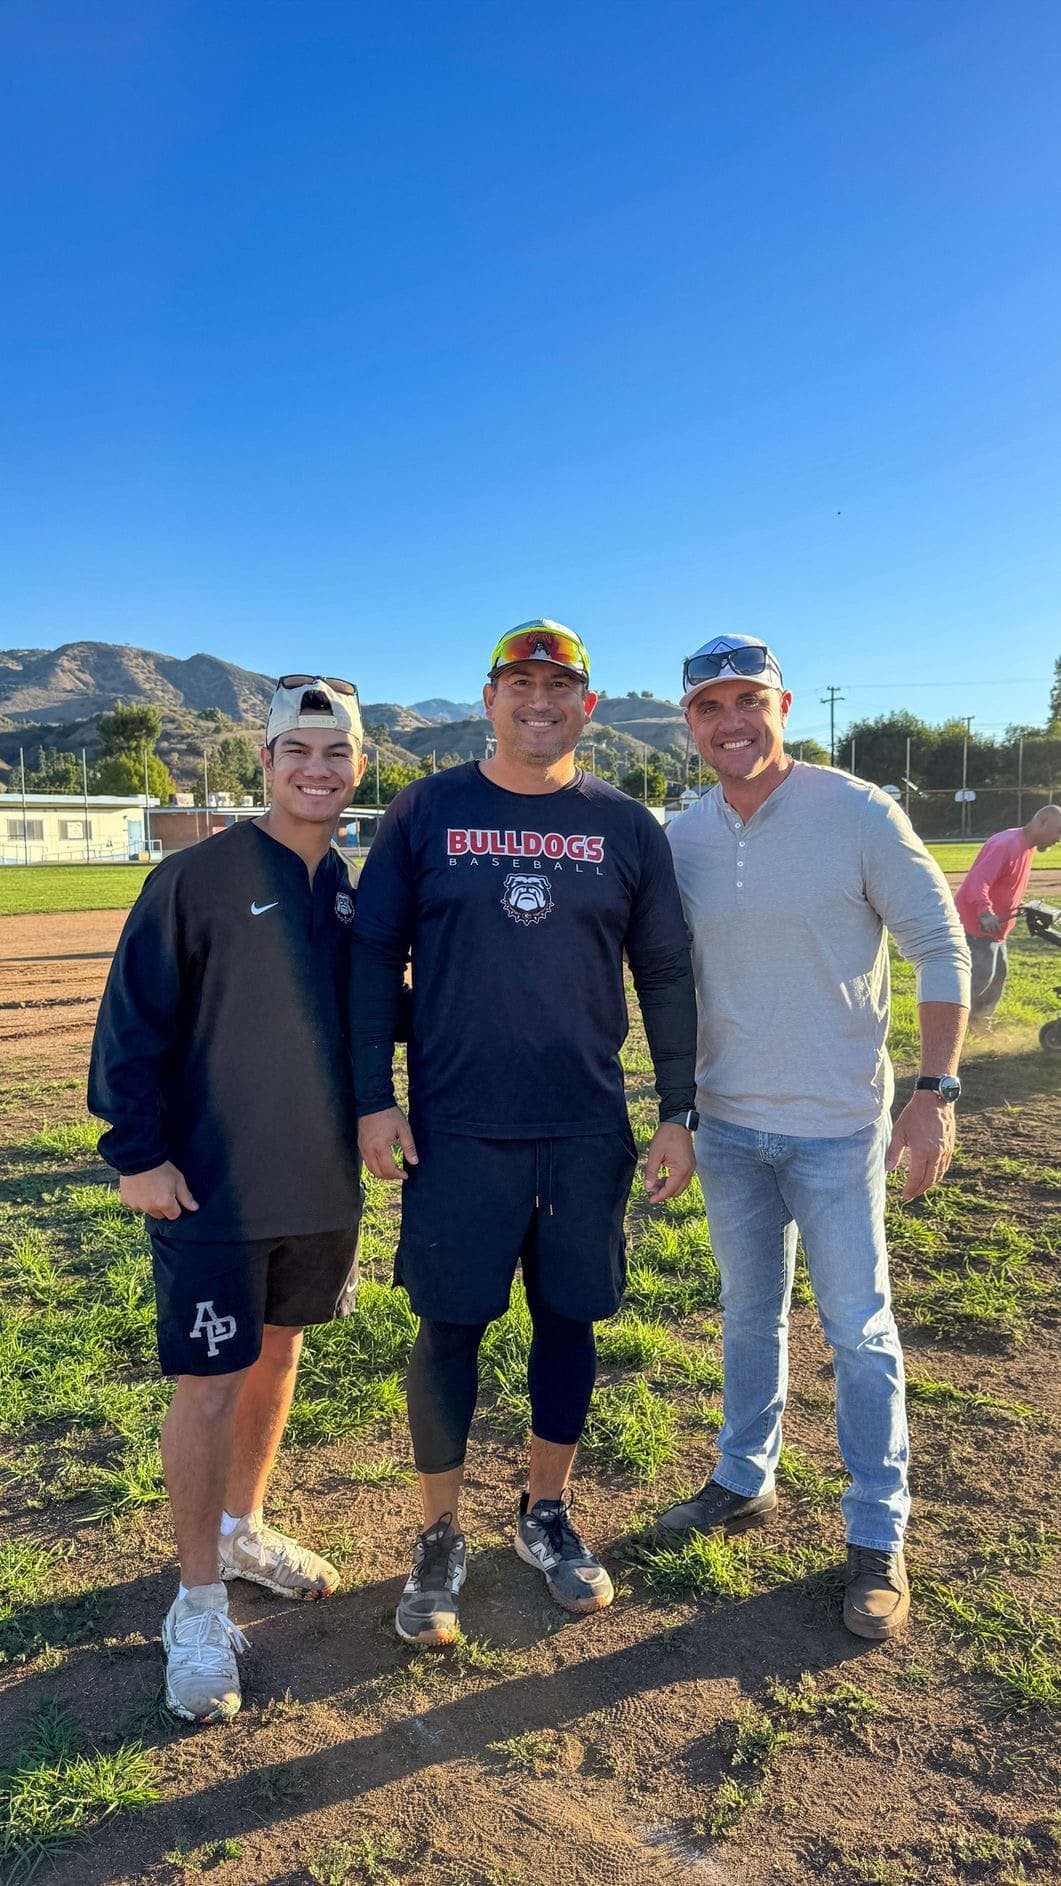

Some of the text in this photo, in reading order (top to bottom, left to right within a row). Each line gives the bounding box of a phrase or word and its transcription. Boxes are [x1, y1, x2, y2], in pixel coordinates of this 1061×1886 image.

[447, 828, 605, 863] BULLDOGS
[450, 857, 603, 876] BASEBALL
[189, 1300, 237, 1357] AP
